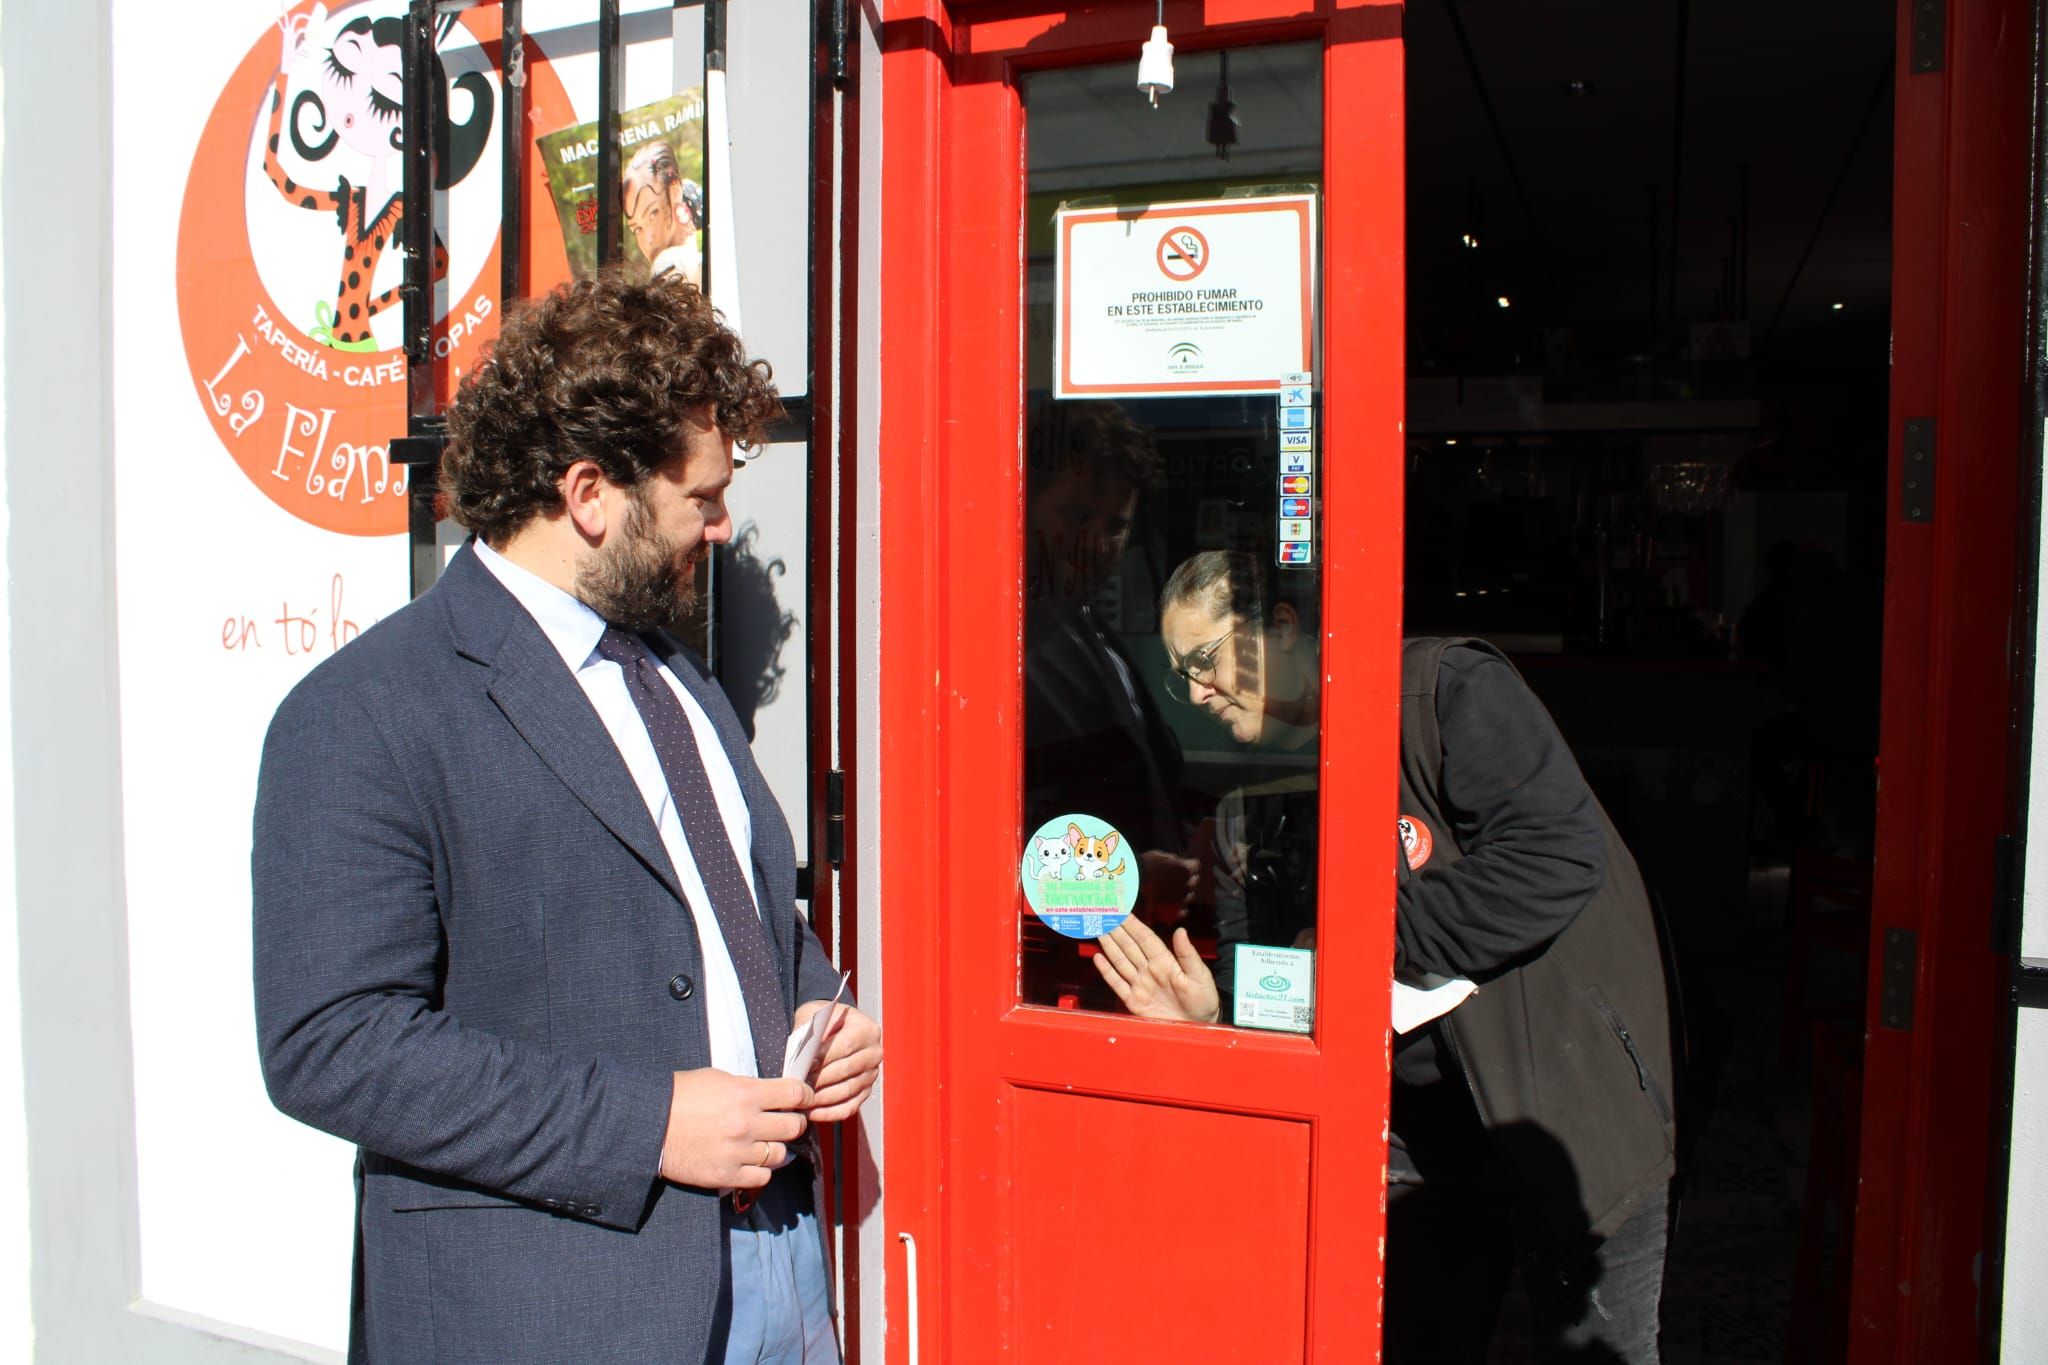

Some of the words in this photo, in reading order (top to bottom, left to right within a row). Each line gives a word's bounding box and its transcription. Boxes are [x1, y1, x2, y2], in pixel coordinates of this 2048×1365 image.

[559, 121, 662, 164] MACRENA
[1107, 305, 1123, 317] EN
[1126, 304, 1154, 316] ESTE
[1158, 300, 1264, 314] ESTABLECIMIENTO
[1132, 290, 1193, 303] PROHIBIDO
[1197, 288, 1237, 300] FUMAR
[252, 304, 328, 381] TAPERÍA
[344, 355, 405, 387] CAFÉ
[435, 294, 493, 358] OPAS
[203, 333, 265, 438] La
[272, 401, 409, 504] Flam
[1287, 436, 1307, 444] VISA
[223, 616, 262, 651] en
